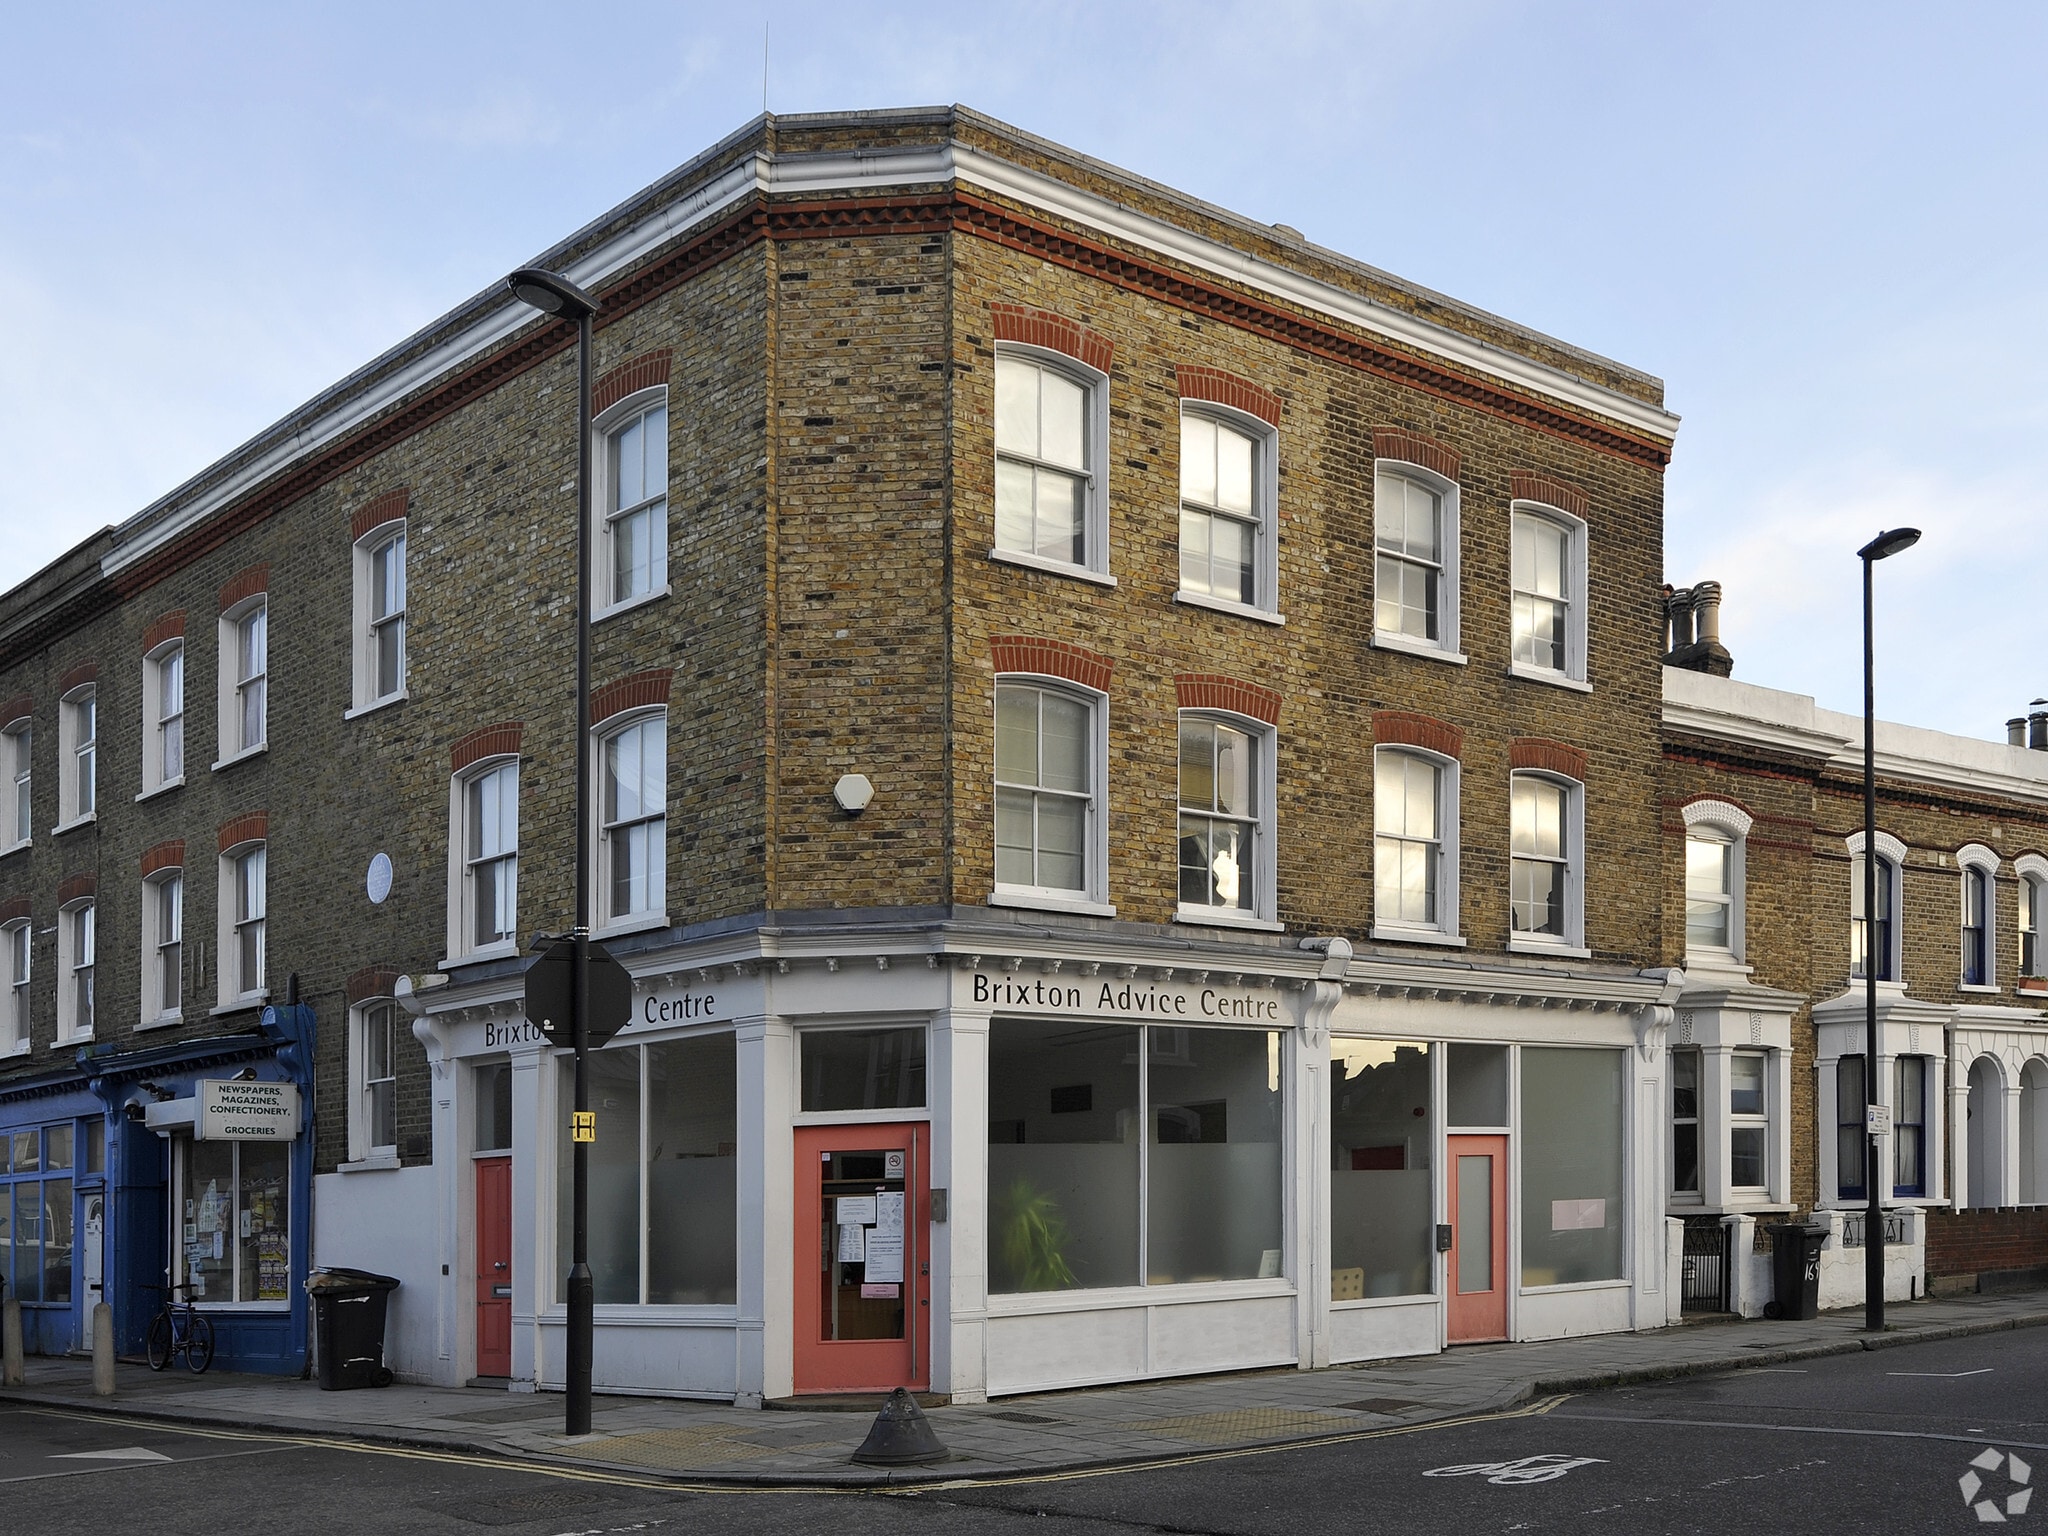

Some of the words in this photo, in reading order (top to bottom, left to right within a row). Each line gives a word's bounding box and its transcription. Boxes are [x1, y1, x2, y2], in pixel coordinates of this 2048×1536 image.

[973, 973, 1081, 1008] Brixton
[1097, 982, 1187, 1015] Advice
[1200, 989, 1279, 1020] Centre
[485, 1020, 547, 1047] Brixto
[644, 993, 715, 1024] Centre
[218, 1085, 283, 1096] NEWSPAPERS,
[221, 1096, 280, 1106] MAGAZINES,
[209, 1105, 291, 1117] CONFECTIONERY,
[224, 1126, 276, 1135] GROCERIES
[577, 1115, 592, 1138] H
